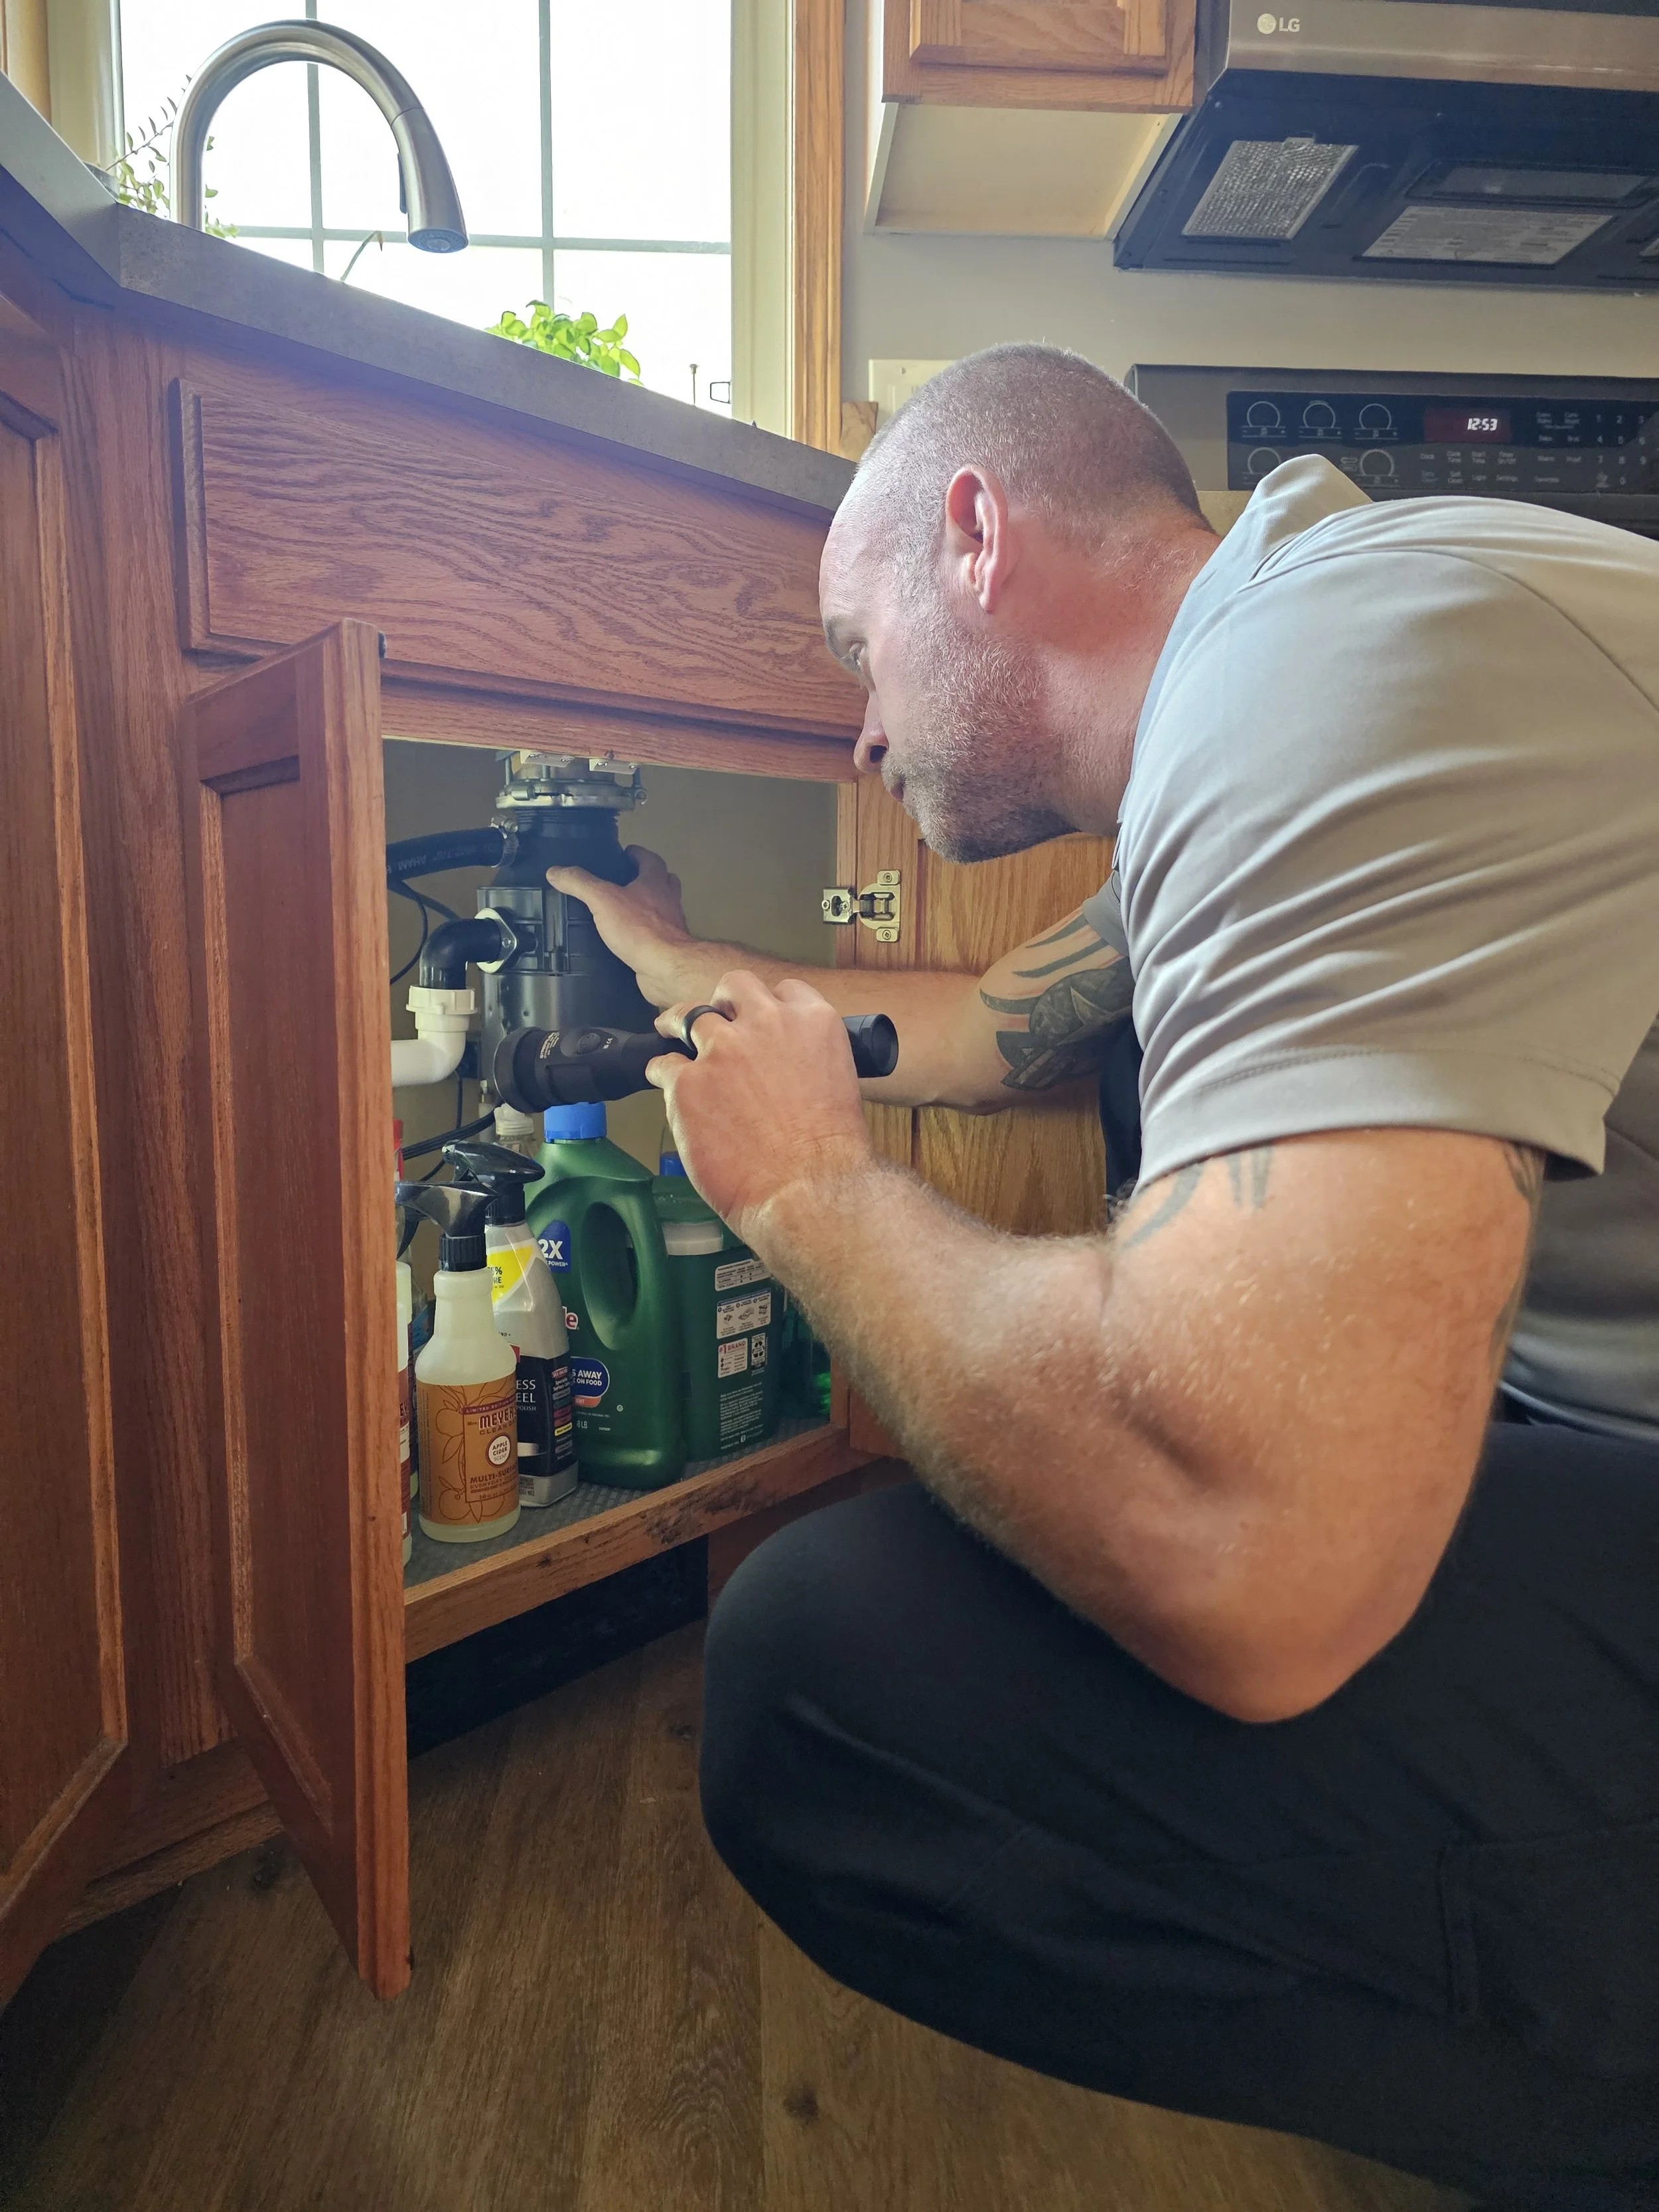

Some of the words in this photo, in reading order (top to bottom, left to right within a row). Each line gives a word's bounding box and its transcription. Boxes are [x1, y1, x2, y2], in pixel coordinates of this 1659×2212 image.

[1279, 17, 1300, 33] LG
[1467, 418, 1498, 431] 12:53
[538, 1239, 563, 1260] 2X
[727, 1340, 746, 1351] BRAND
[578, 1370, 602, 1380] AWAY
[516, 1380, 536, 1390] ESS
[516, 1392, 536, 1403] EEL
[479, 1424, 507, 1435] CLEAN
[492, 1441, 507, 1451] APPLE
[493, 1447, 507, 1456] CIDER
[494, 1453, 507, 1461] SCENT
[470, 1465, 517, 1484] MULTI-SURFA
[470, 1479, 502, 1489] EVERYDAY
